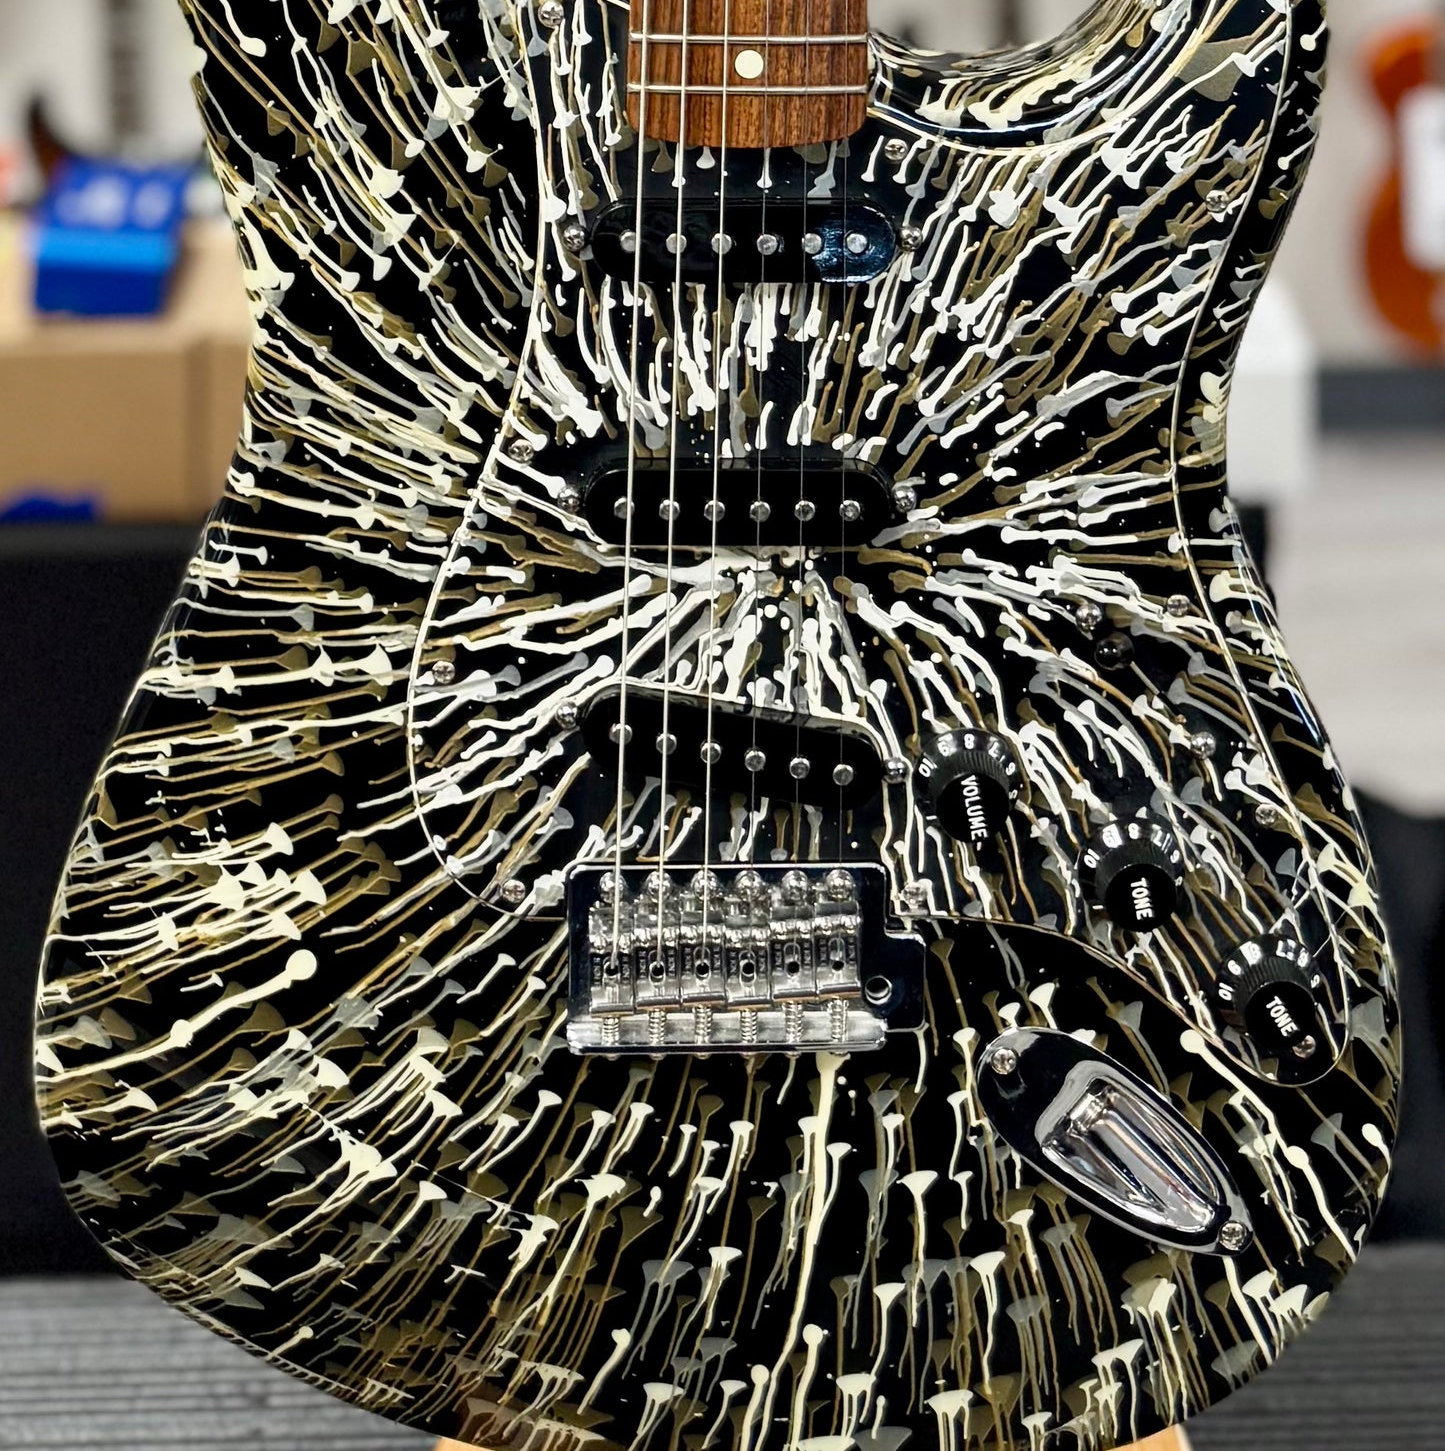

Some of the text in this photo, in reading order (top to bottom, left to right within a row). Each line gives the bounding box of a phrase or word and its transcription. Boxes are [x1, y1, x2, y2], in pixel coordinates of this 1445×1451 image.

[963, 733, 975, 750] 8
[918, 758, 937, 778] 10
[960, 774, 988, 841] VOLUME
[1128, 822, 1140, 840] 8
[1083, 848, 1101, 869] 10
[1130, 877, 1154, 920] TONE
[1218, 982, 1235, 1001] 10
[1266, 995, 1299, 1037] TONE
